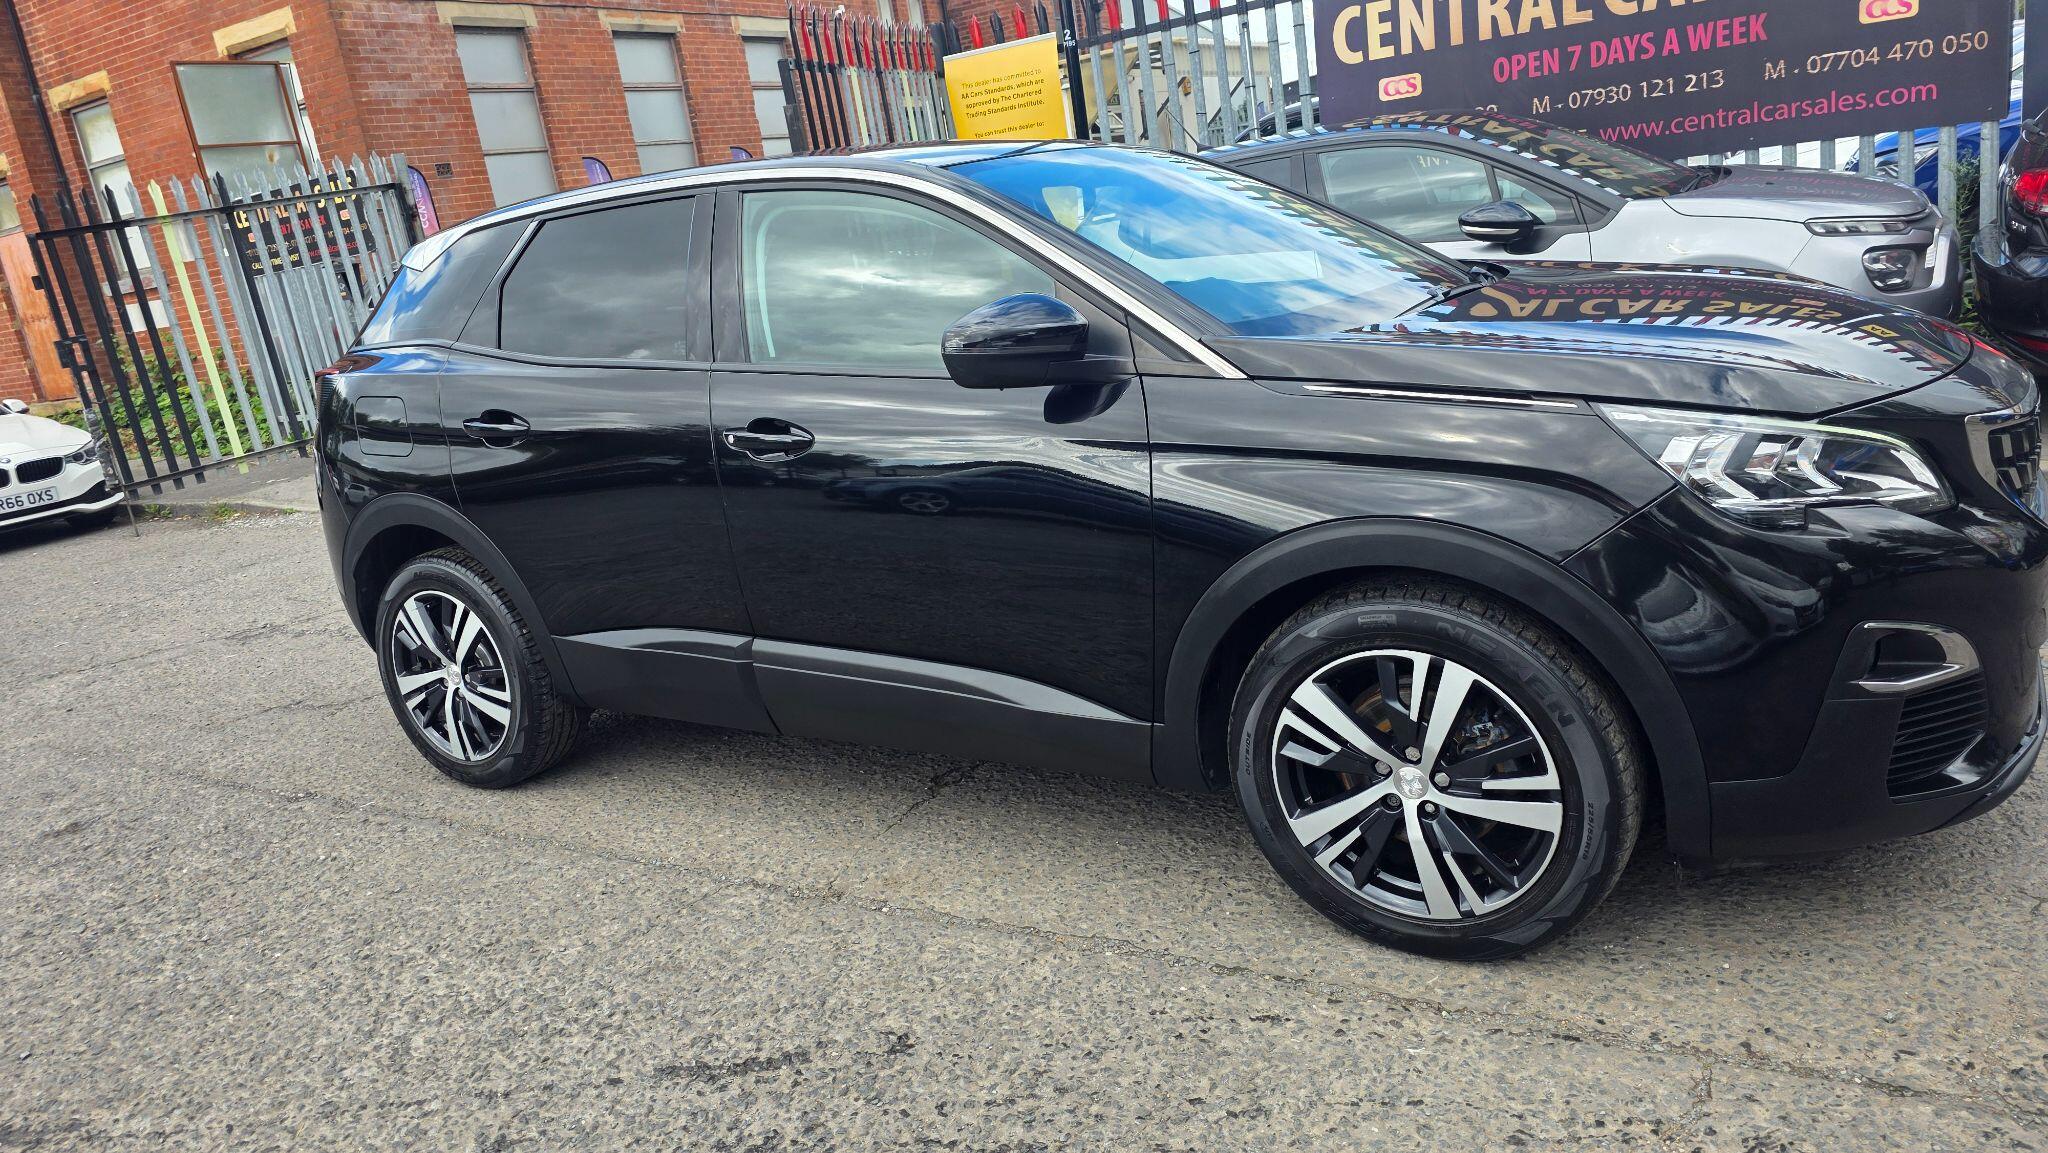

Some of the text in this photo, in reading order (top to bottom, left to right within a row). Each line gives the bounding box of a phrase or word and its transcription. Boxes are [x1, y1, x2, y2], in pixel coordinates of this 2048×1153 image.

[1063, 29, 1072, 41] 2
[1493, 13, 1768, 83] OPEN 7 DAYS A WEEK
[1763, 31, 1989, 80] M 07704 470 050
[1016, 80, 1033, 89] which
[1532, 96, 1550, 114] M
[1568, 84, 1632, 109] 07930
[1640, 77, 1674, 98] 121
[1684, 69, 1725, 93] 213
[966, 98, 991, 109] approved
[1012, 88, 1042, 100] Chartered
[966, 110, 987, 119] Trading
[987, 104, 1017, 115] Standards
[1600, 83, 1937, 142] www.centralcarsales.com
[27, 490, 53, 504] OXS
